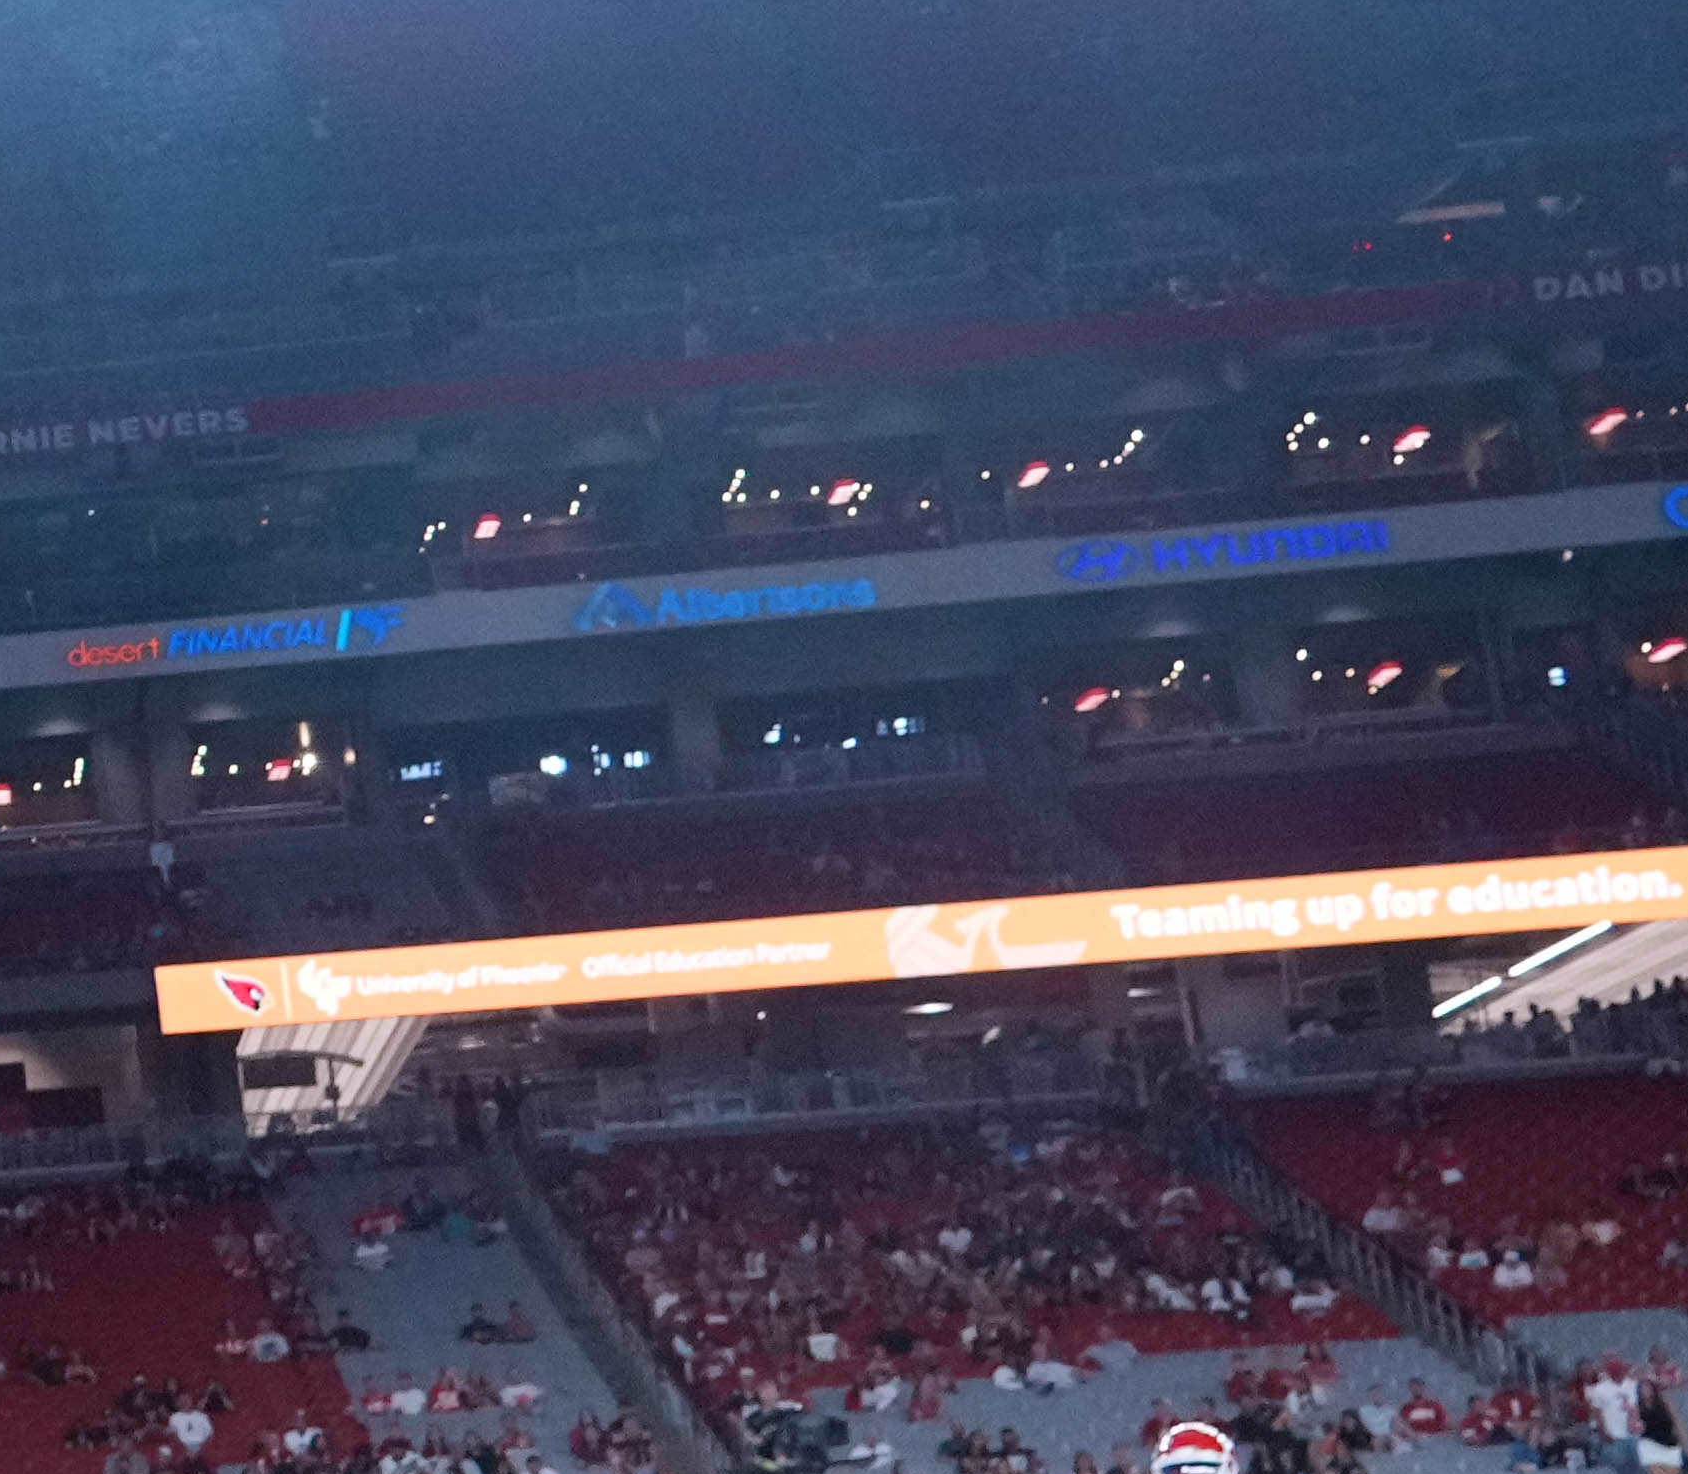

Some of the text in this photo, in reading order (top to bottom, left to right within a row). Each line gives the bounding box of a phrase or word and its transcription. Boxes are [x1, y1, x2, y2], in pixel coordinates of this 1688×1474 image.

[87, 406, 249, 444] NEVERS
[1151, 521, 1390, 571] HYUNDAI
[67, 619, 327, 668] desert FINANCIAL
[1110, 866, 1683, 938] Teaming up for education.
